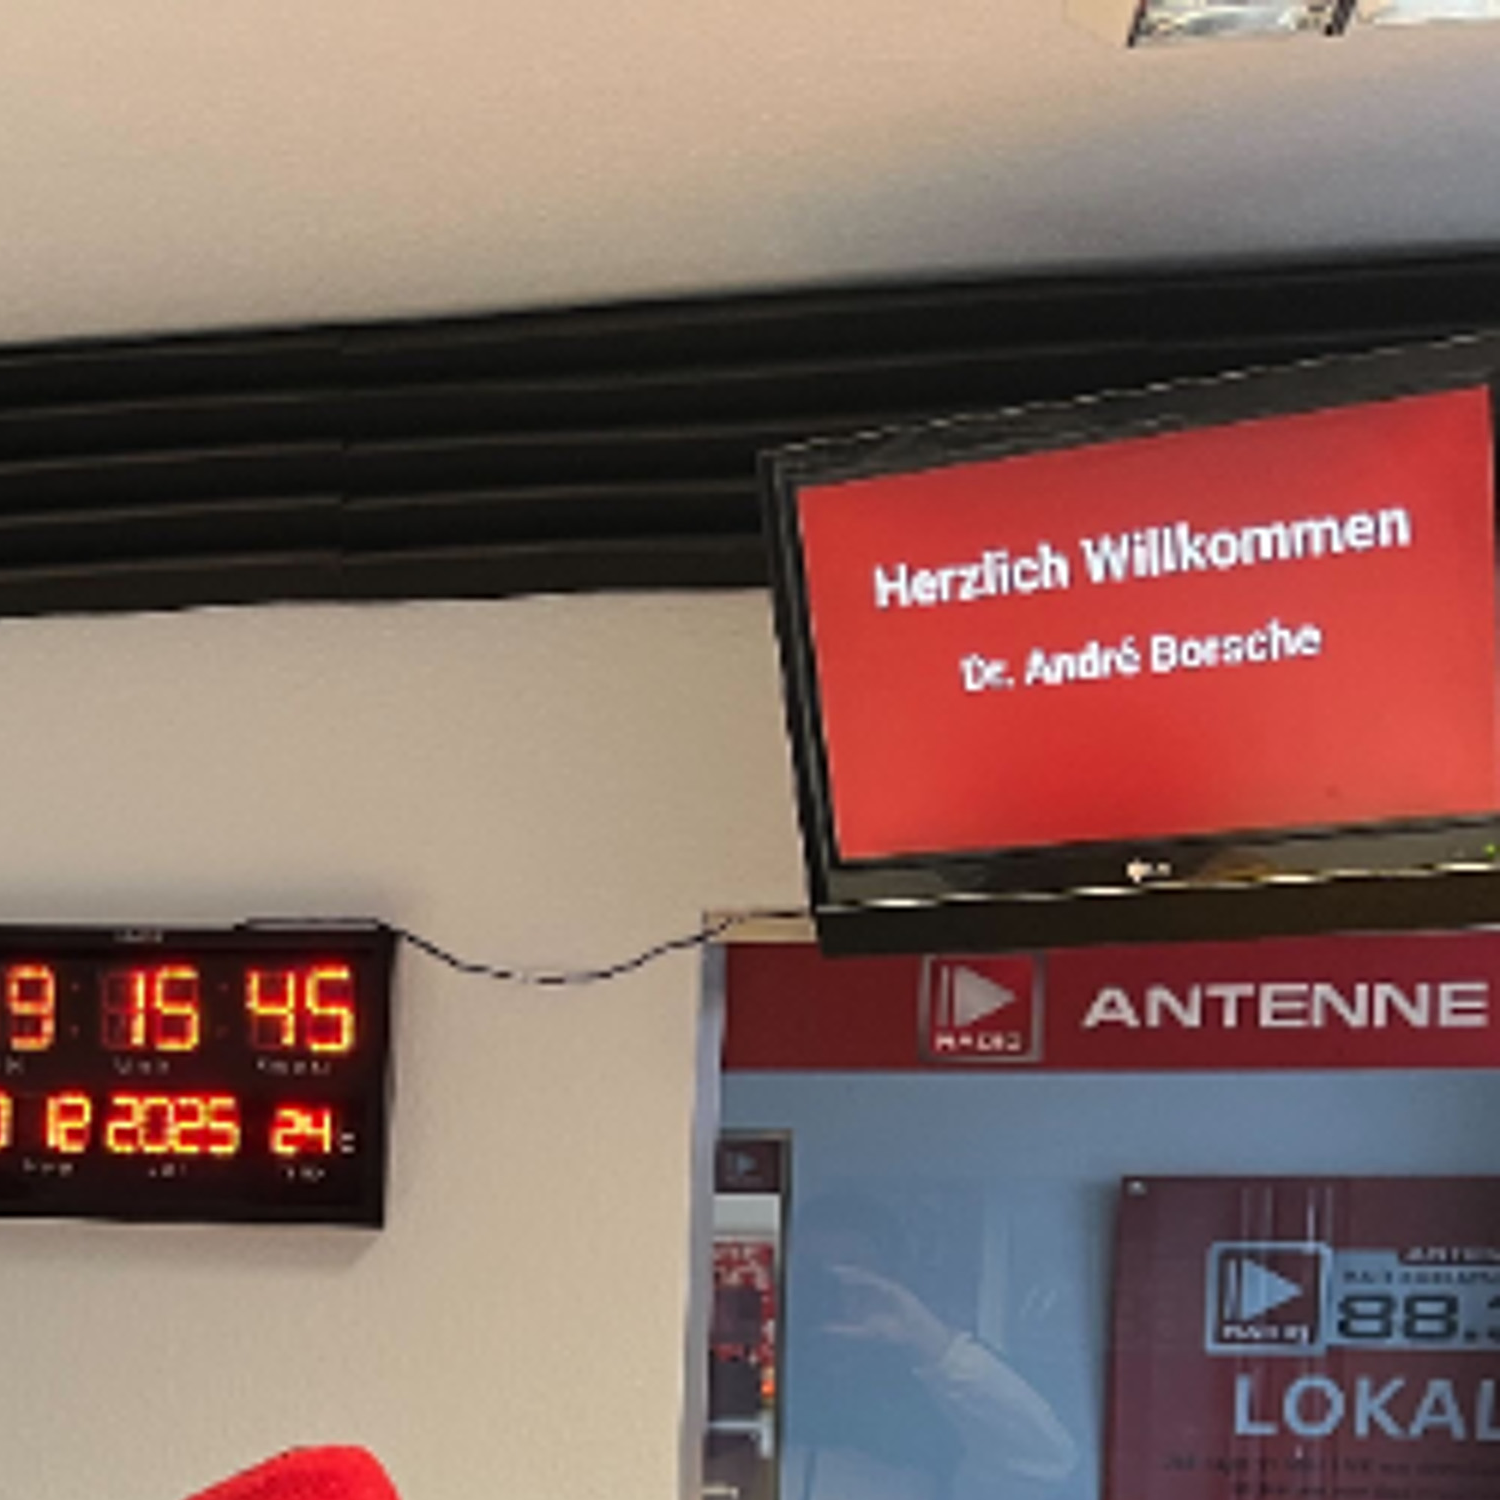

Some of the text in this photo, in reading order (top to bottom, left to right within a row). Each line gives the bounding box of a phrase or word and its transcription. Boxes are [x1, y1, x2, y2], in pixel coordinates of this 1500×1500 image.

[873, 507, 1412, 607] Herzlich Willkommen
[960, 620, 1322, 692] Dr. André Borsche
[6, 966, 355, 1053] 9 15 45
[1083, 983, 1488, 1029] ANTENNE
[105, 1095, 240, 1153] 2025
[270, 1107, 332, 1154] 24
[1337, 1294, 1500, 1342] 88.
[1234, 1374, 1500, 1442] LOKAL
